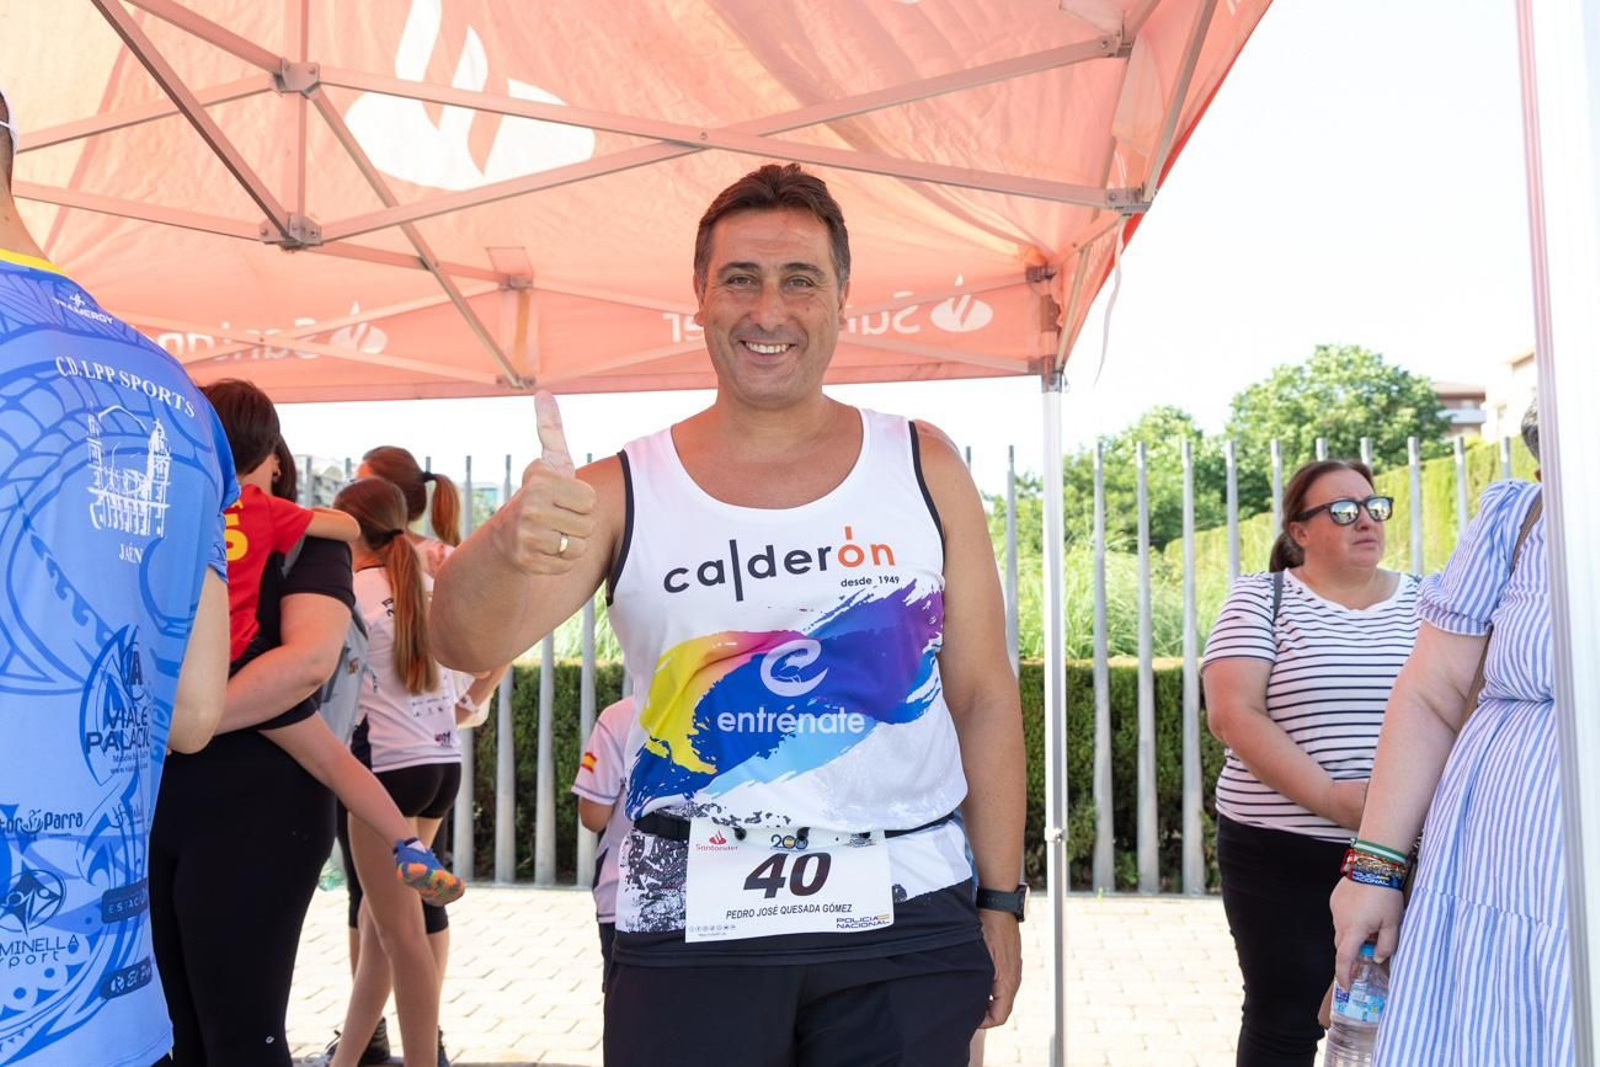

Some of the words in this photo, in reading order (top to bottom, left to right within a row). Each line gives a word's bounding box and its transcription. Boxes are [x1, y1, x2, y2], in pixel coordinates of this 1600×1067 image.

[82, 361, 115, 382] LPP
[119, 370, 195, 418] SPORTS
[663, 526, 896, 602] calderón
[840, 577, 872, 588] desde
[878, 575, 900, 585] 1949
[717, 704, 866, 734] entrénate
[44, 811, 84, 830] Parra
[695, 843, 739, 852] Santander
[743, 852, 832, 899] 40
[726, 909, 755, 920] PEDRO
[757, 905, 779, 917] JOSÉ
[780, 904, 820, 915] QUESADA
[822, 903, 853, 913] GÓMEZ
[836, 920, 890, 929] NACIONAL
[0, 950, 60, 969] port
